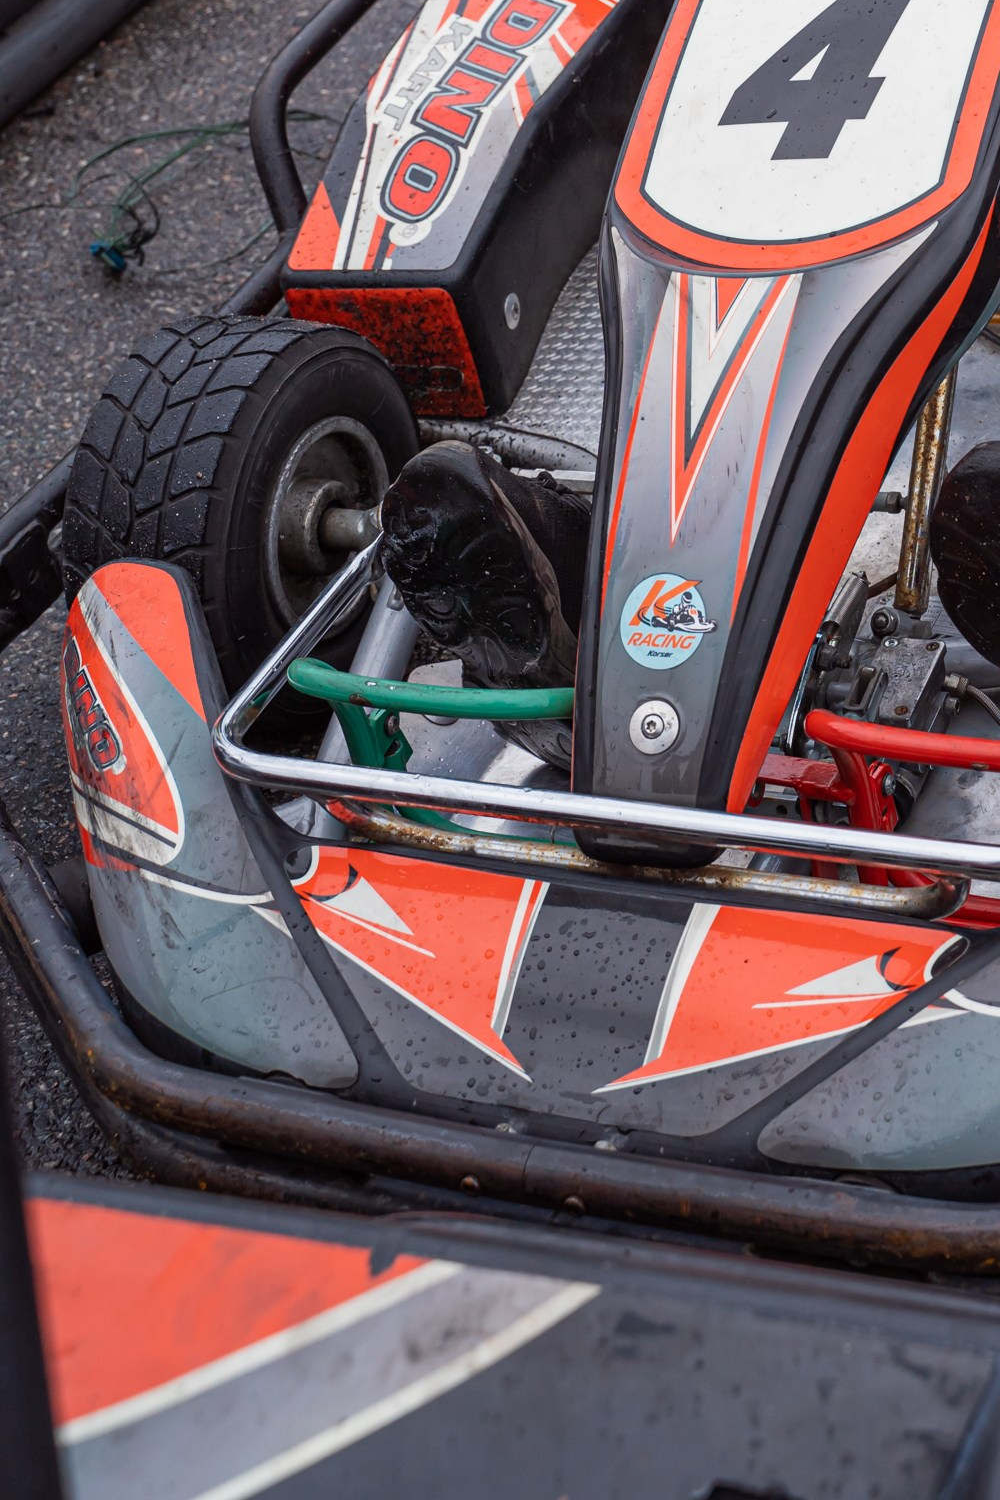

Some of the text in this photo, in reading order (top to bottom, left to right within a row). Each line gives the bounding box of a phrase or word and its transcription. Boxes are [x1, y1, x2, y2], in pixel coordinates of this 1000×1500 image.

[383, 20, 474, 132] KART
[628, 580, 703, 626] K
[627, 632, 696, 649] RACING
